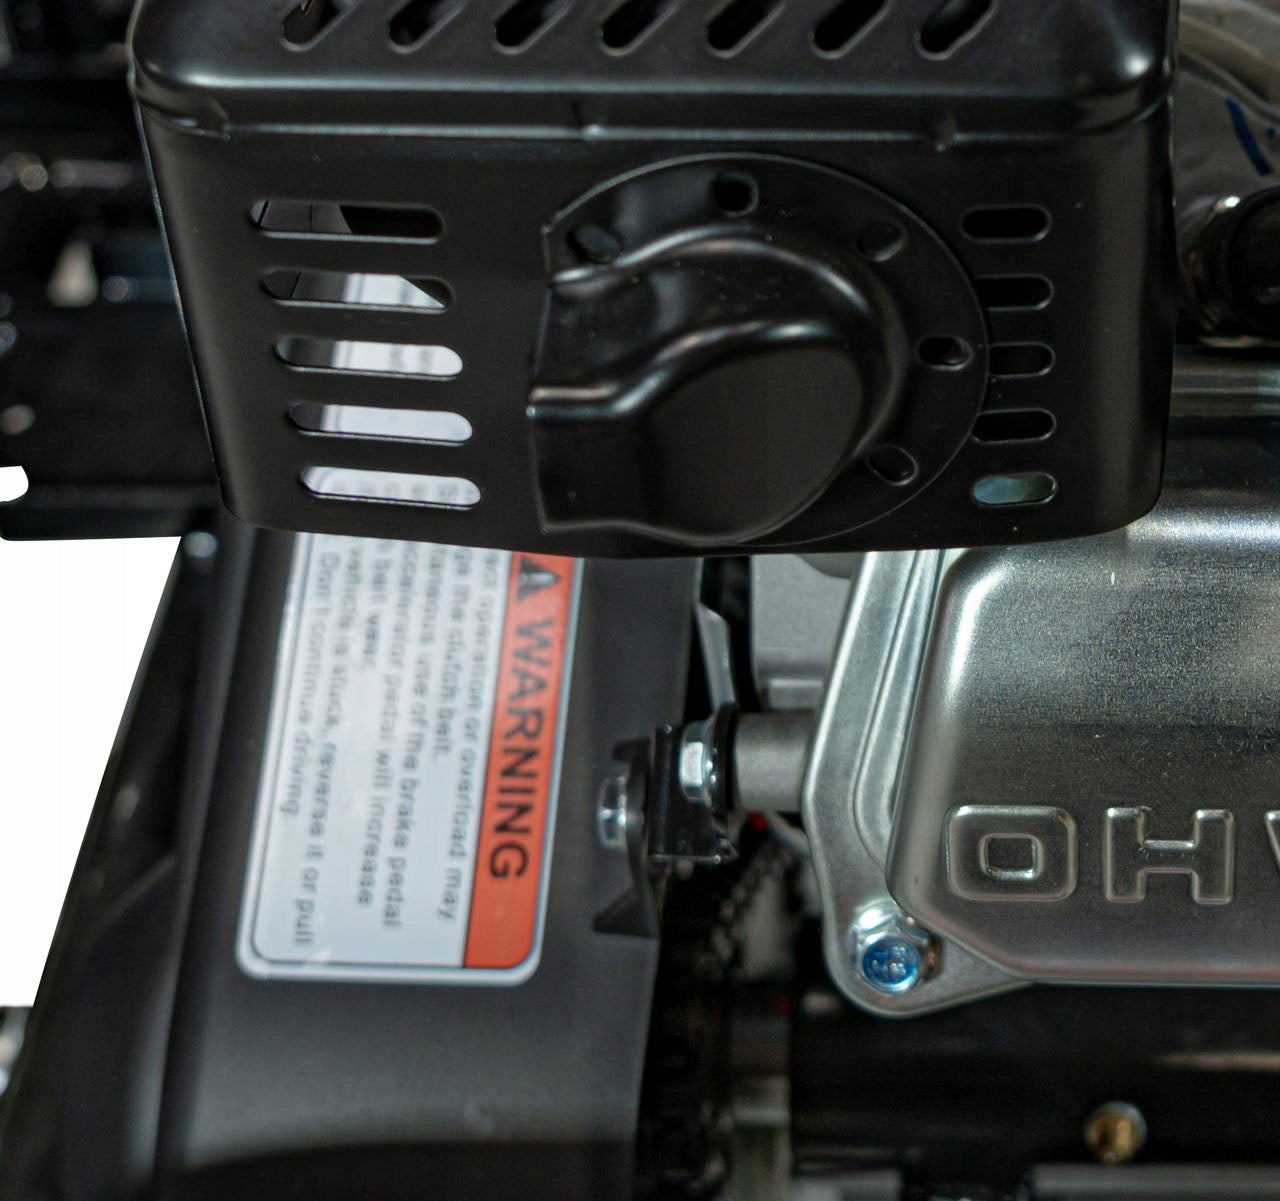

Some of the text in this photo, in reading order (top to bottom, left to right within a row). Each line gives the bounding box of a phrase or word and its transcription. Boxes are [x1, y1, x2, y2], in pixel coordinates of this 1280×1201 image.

[449, 584, 471, 619] the
[296, 622, 331, 722] continue
[438, 626, 466, 699] clutch
[463, 594, 495, 710] operation
[356, 541, 421, 905] ccelerator pedal will increase
[378, 549, 447, 927] taneous use of the brake pedal
[463, 716, 479, 740] or
[487, 617, 554, 879] WARNING
[306, 741, 337, 837] reverse
[448, 748, 478, 856] overload
[299, 866, 320, 894] or
[304, 843, 326, 861] it
[435, 867, 461, 920] may
[288, 897, 320, 943] pull
